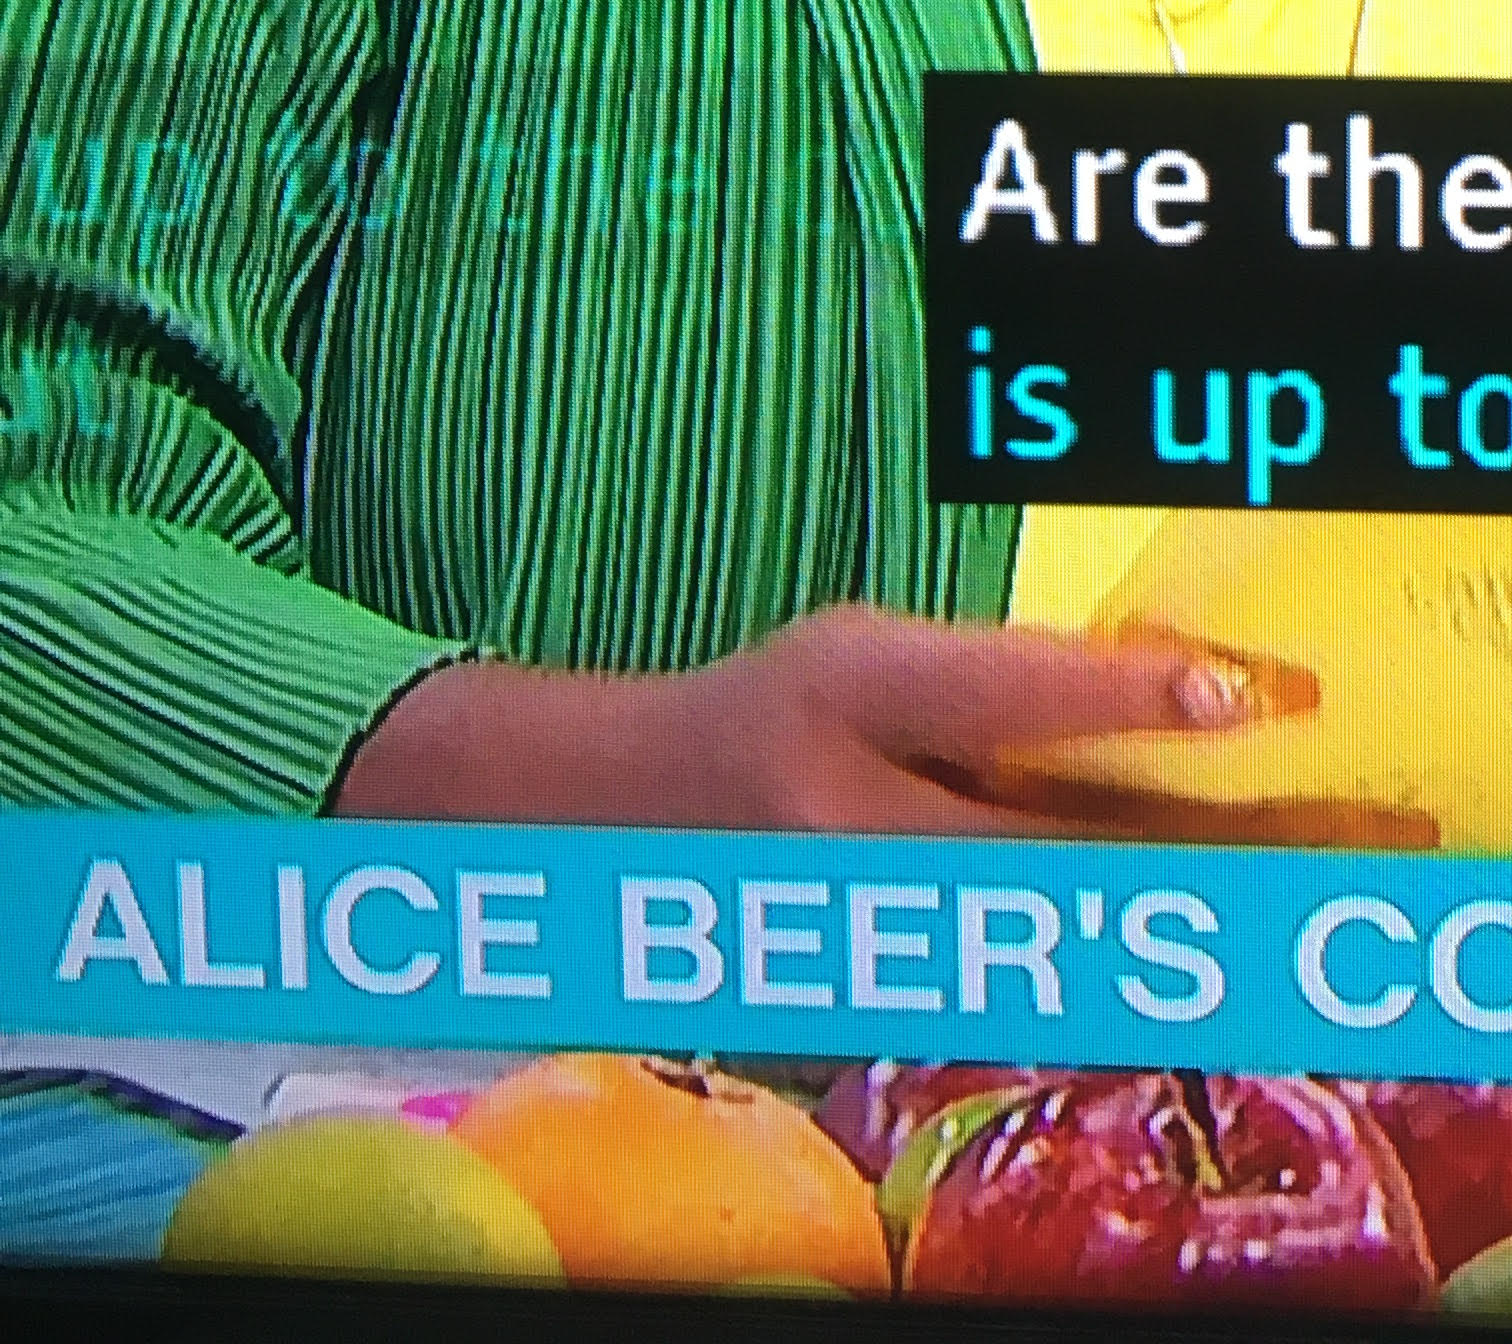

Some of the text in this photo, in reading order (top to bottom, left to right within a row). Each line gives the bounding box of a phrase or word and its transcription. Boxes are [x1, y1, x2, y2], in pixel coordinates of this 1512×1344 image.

[960, 117, 1210, 246] Are
[966, 324, 1079, 461] is
[1151, 367, 1327, 507] up
[55, 857, 552, 999] ALICE
[618, 872, 1227, 1023] BEER'S
